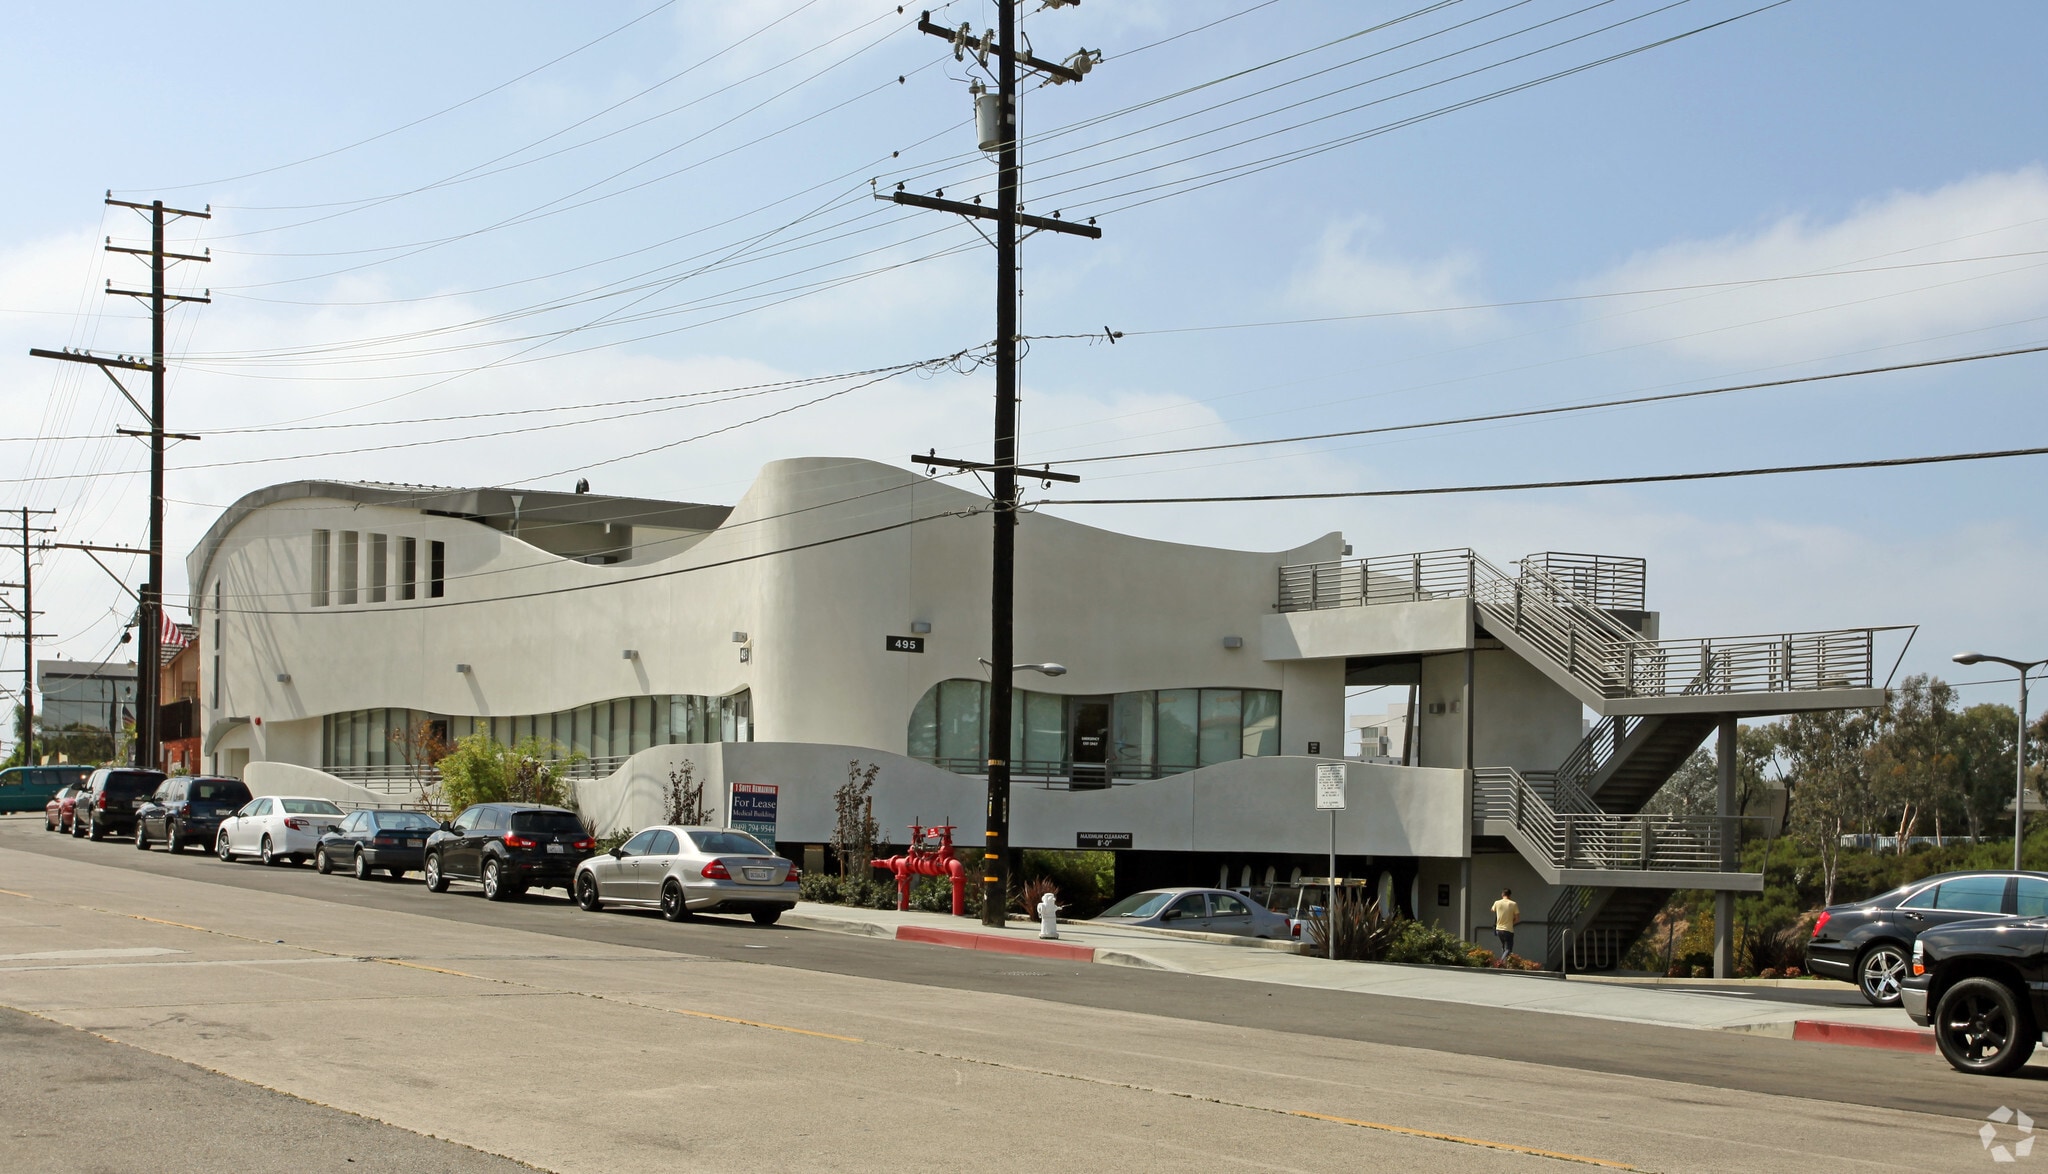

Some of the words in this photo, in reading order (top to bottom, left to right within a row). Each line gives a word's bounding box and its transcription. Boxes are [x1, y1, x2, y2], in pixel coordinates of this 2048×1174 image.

[895, 640, 916, 650] 495
[734, 797, 749, 807] For
[752, 798, 776, 808] Lease
